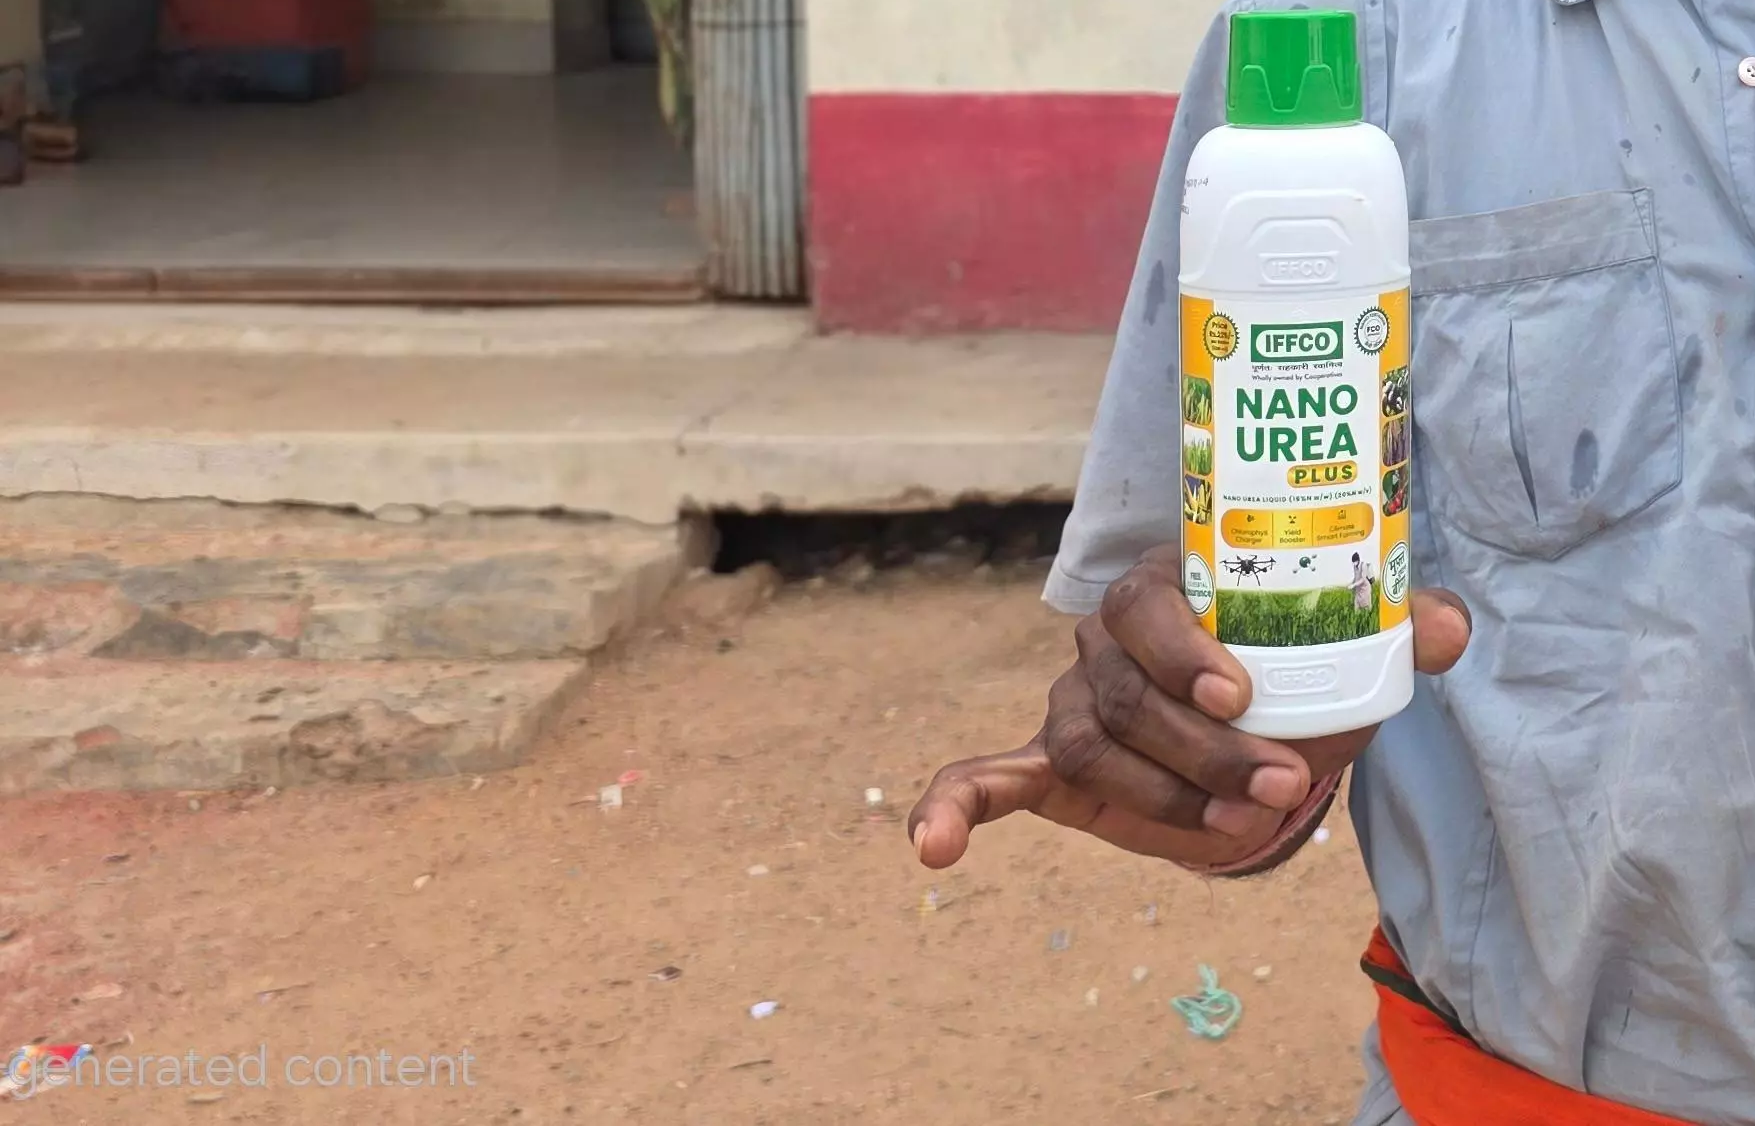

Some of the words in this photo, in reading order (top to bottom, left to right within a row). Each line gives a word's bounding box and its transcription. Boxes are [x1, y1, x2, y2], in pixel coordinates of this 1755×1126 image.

[1272, 260, 1328, 276] IFFCO
[1366, 324, 1381, 333] FCO
[1265, 331, 1331, 352] IFFCO
[1251, 374, 1272, 382] Wholly
[1295, 374, 1303, 382] by
[1304, 372, 1343, 380] Cooperatives
[1236, 384, 1358, 419] NANO
[1236, 422, 1358, 462] UREA
[1294, 464, 1353, 485] PLUS
[1223, 494, 1241, 502] NANO
[1262, 495, 1287, 504] LIQUID
[1235, 536, 1262, 545] Charger
[1279, 536, 1306, 544] Booster
[1316, 533, 1338, 542] Smart
